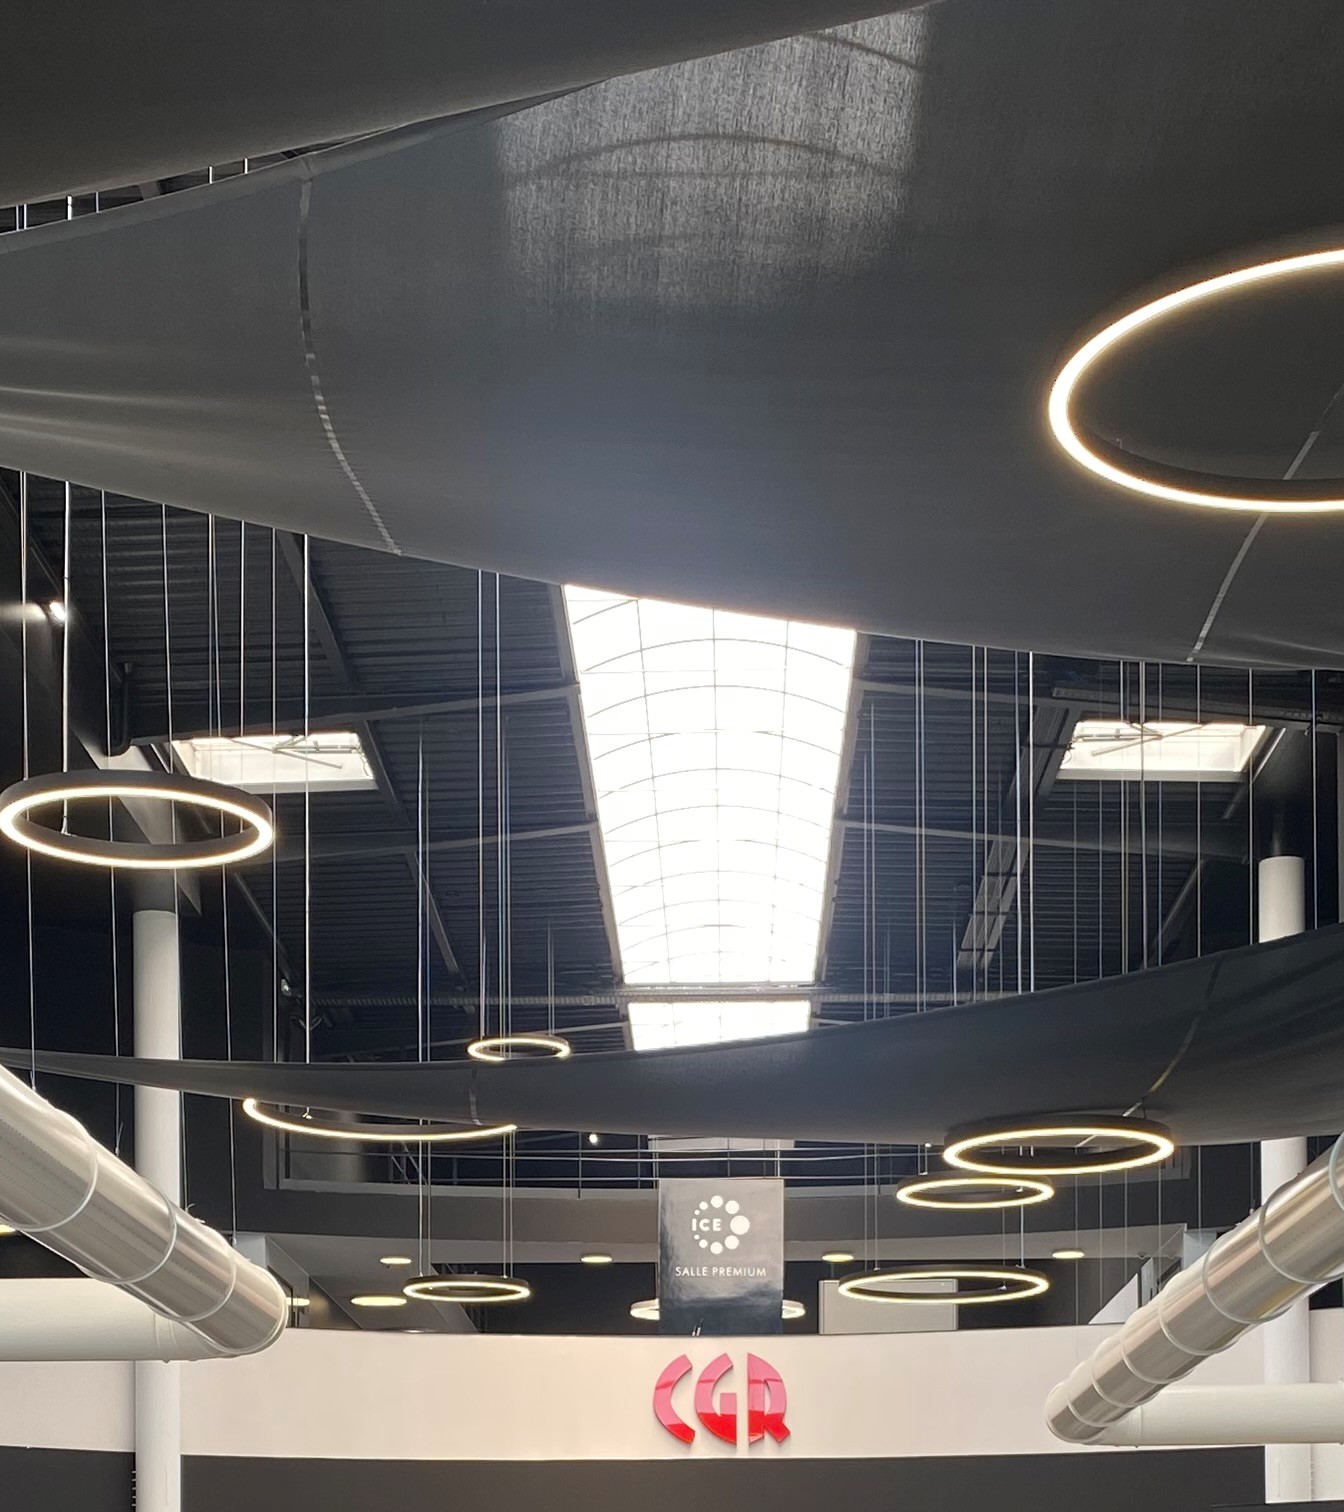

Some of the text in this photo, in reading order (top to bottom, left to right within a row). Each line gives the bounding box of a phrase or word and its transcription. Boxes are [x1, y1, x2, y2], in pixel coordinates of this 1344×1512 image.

[692, 1218, 721, 1231] ICE
[675, 1266, 766, 1277] SALLE PREMIUM
[653, 1352, 791, 1446] CGR
